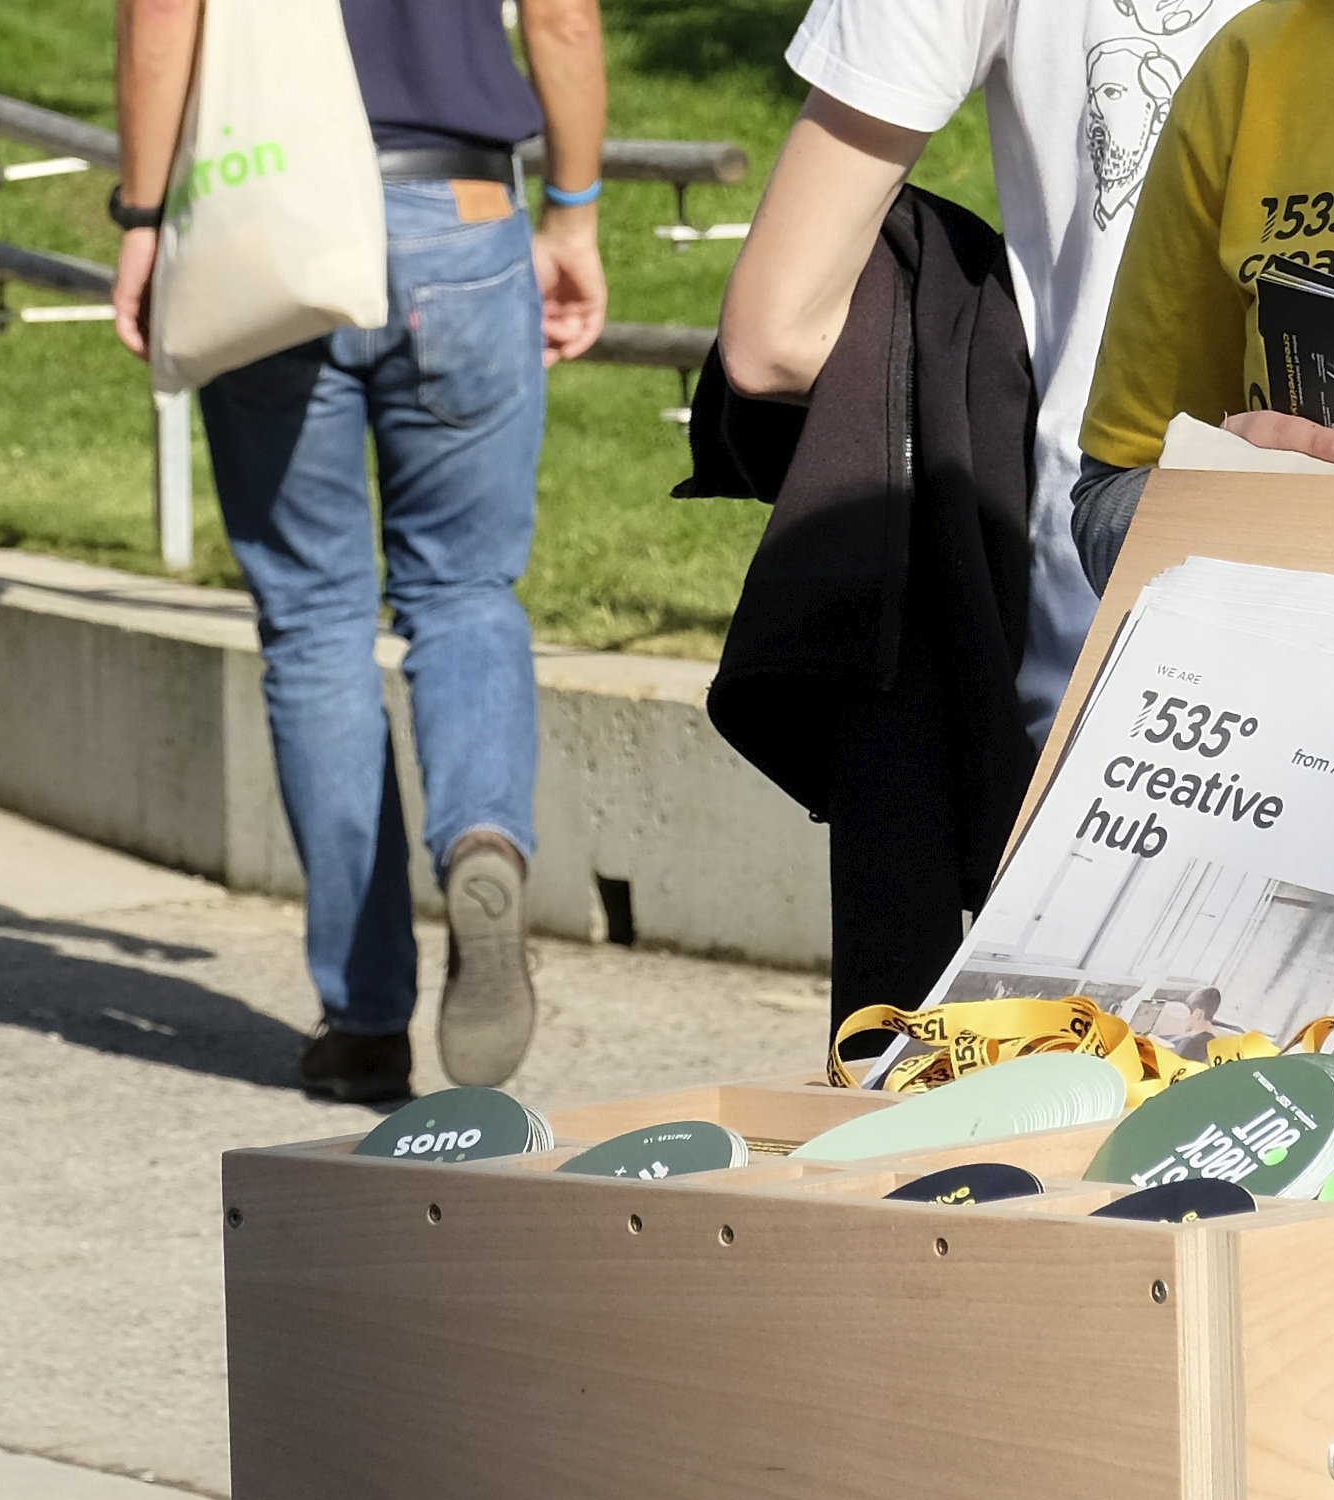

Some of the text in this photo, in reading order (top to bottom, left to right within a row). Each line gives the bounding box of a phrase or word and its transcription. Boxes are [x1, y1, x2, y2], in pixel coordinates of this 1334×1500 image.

[1156, 663, 1203, 685] WE ARE
[1129, 689, 1259, 758] 1535°
[1291, 748, 1329, 773] from
[1103, 755, 1284, 829] creative
[1075, 797, 1168, 859] hub
[393, 1127, 482, 1157] sono
